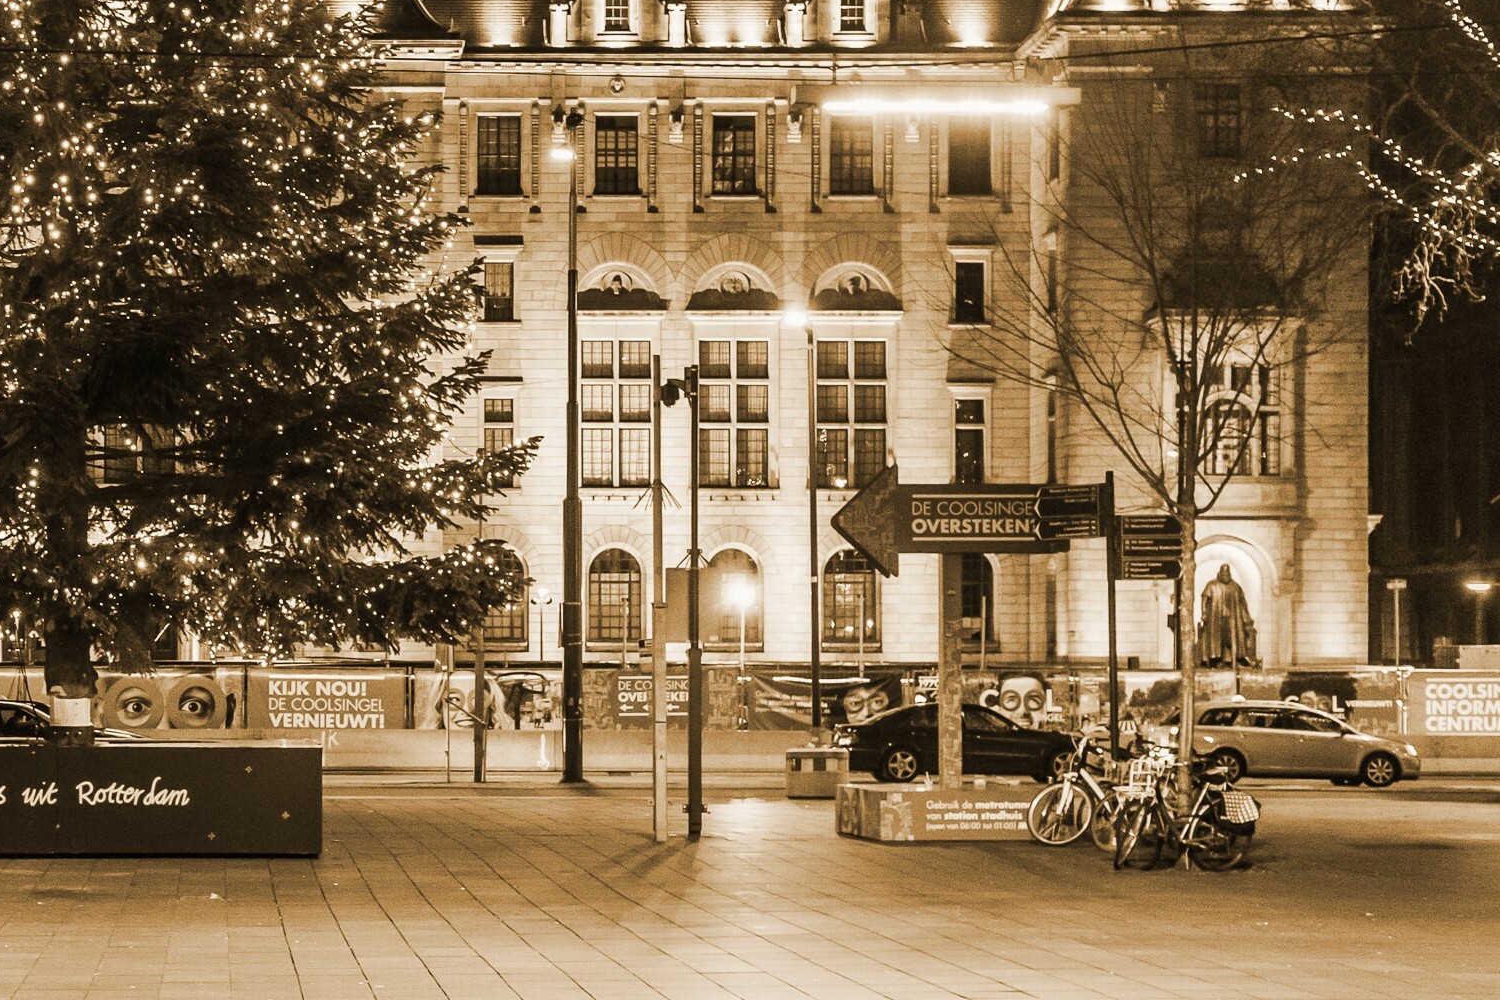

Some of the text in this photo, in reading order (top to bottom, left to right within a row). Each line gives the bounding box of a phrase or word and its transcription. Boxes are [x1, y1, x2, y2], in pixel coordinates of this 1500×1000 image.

[911, 501, 1034, 516] DE COOLSINGE
[268, 680, 367, 697] KIJK NOU!
[618, 680, 632, 691] DE
[268, 697, 384, 712] DE COOLSINGEL
[268, 712, 385, 729] VERNIEUWT!
[1425, 715, 1500, 731] CENTRU
[21, 781, 59, 806] uit
[75, 776, 190, 806] Rotterdam
[926, 799, 1030, 810] Gebruik de metrotunn
[944, 810, 978, 820] station
[981, 810, 1023, 820] stadhuis
